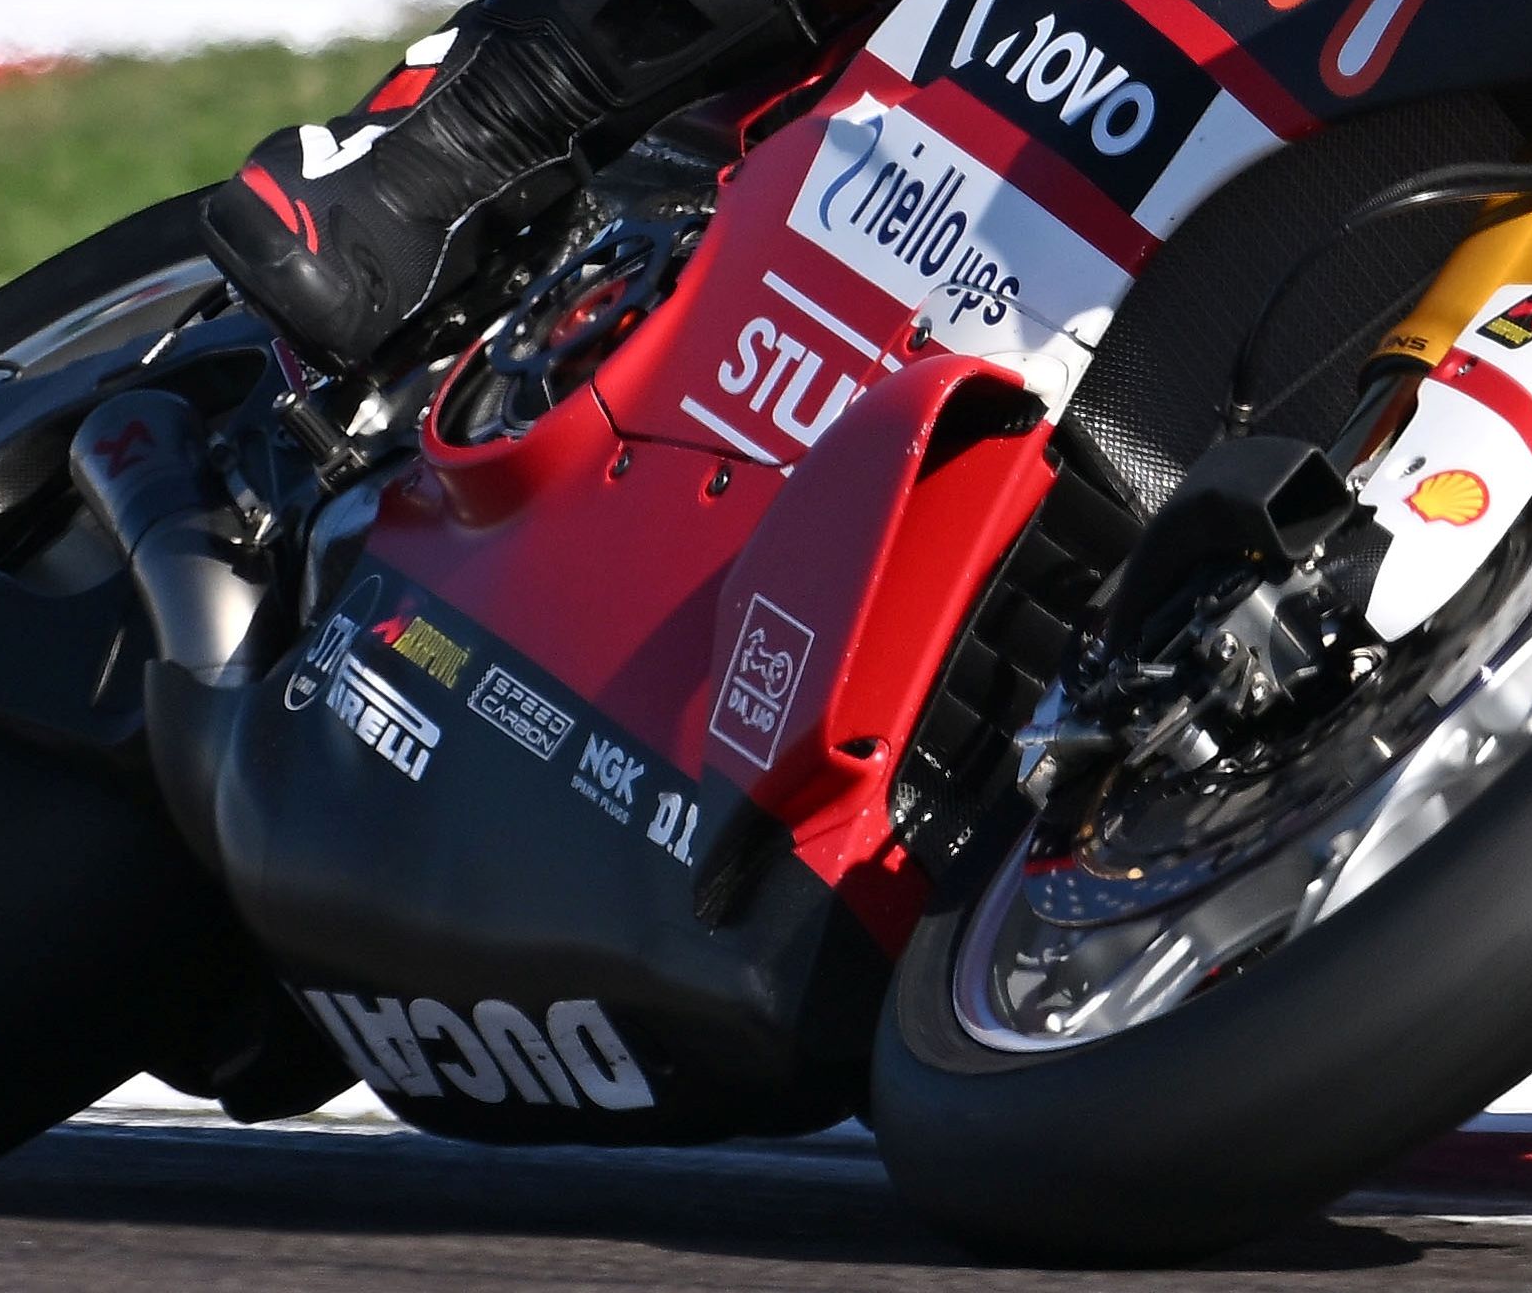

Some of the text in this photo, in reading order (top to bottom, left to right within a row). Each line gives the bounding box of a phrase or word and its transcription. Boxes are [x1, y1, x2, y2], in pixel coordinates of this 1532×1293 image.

[849, 141, 1021, 326] riello ups
[717, 316, 869, 448] STU
[325, 651, 442, 782] PIRELLI
[481, 695, 557, 753] CARBON
[492, 676, 567, 735] SPEED
[578, 731, 646, 807] NGK
[301, 988, 657, 1110] DUCAT
